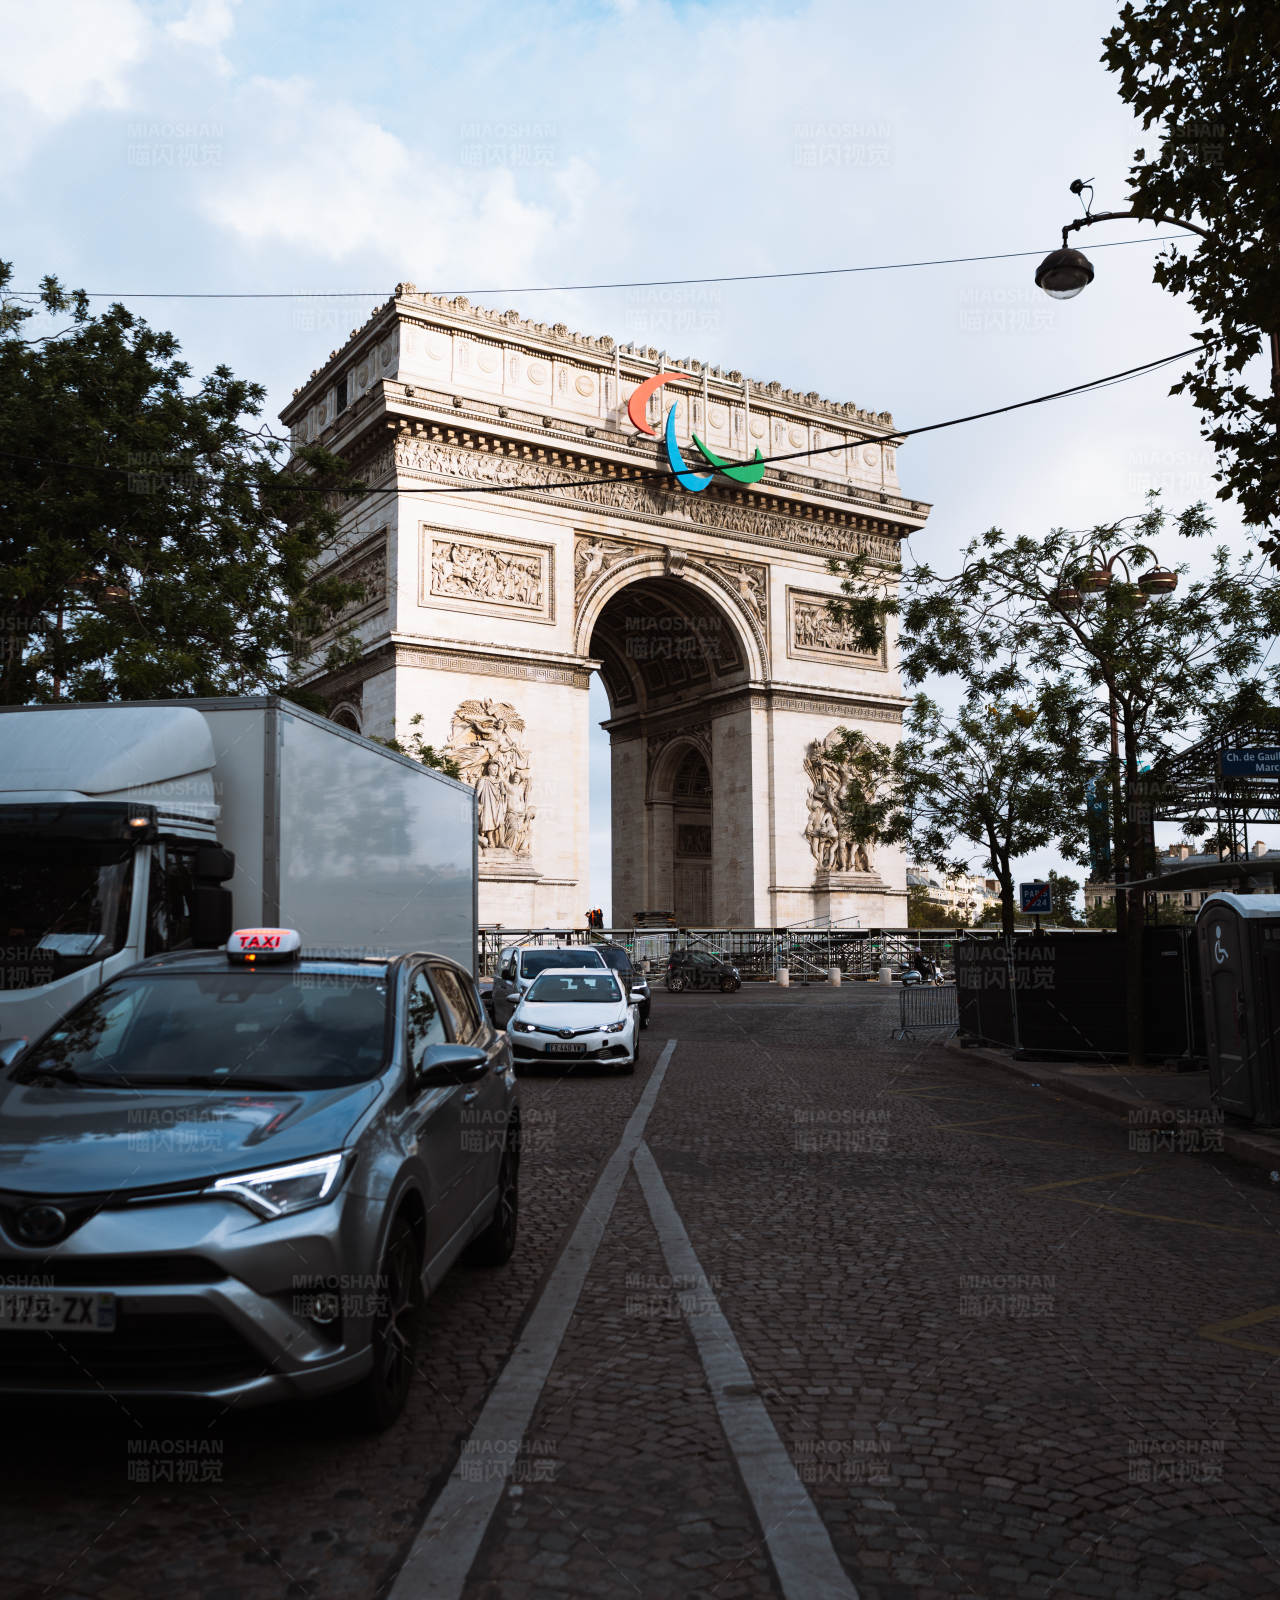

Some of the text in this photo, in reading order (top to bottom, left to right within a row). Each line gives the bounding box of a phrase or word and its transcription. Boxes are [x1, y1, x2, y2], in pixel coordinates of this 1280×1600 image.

[1226, 752, 1242, 762] Ch.
[1243, 752, 1255, 761] de
[240, 936, 281, 948] TAXI
